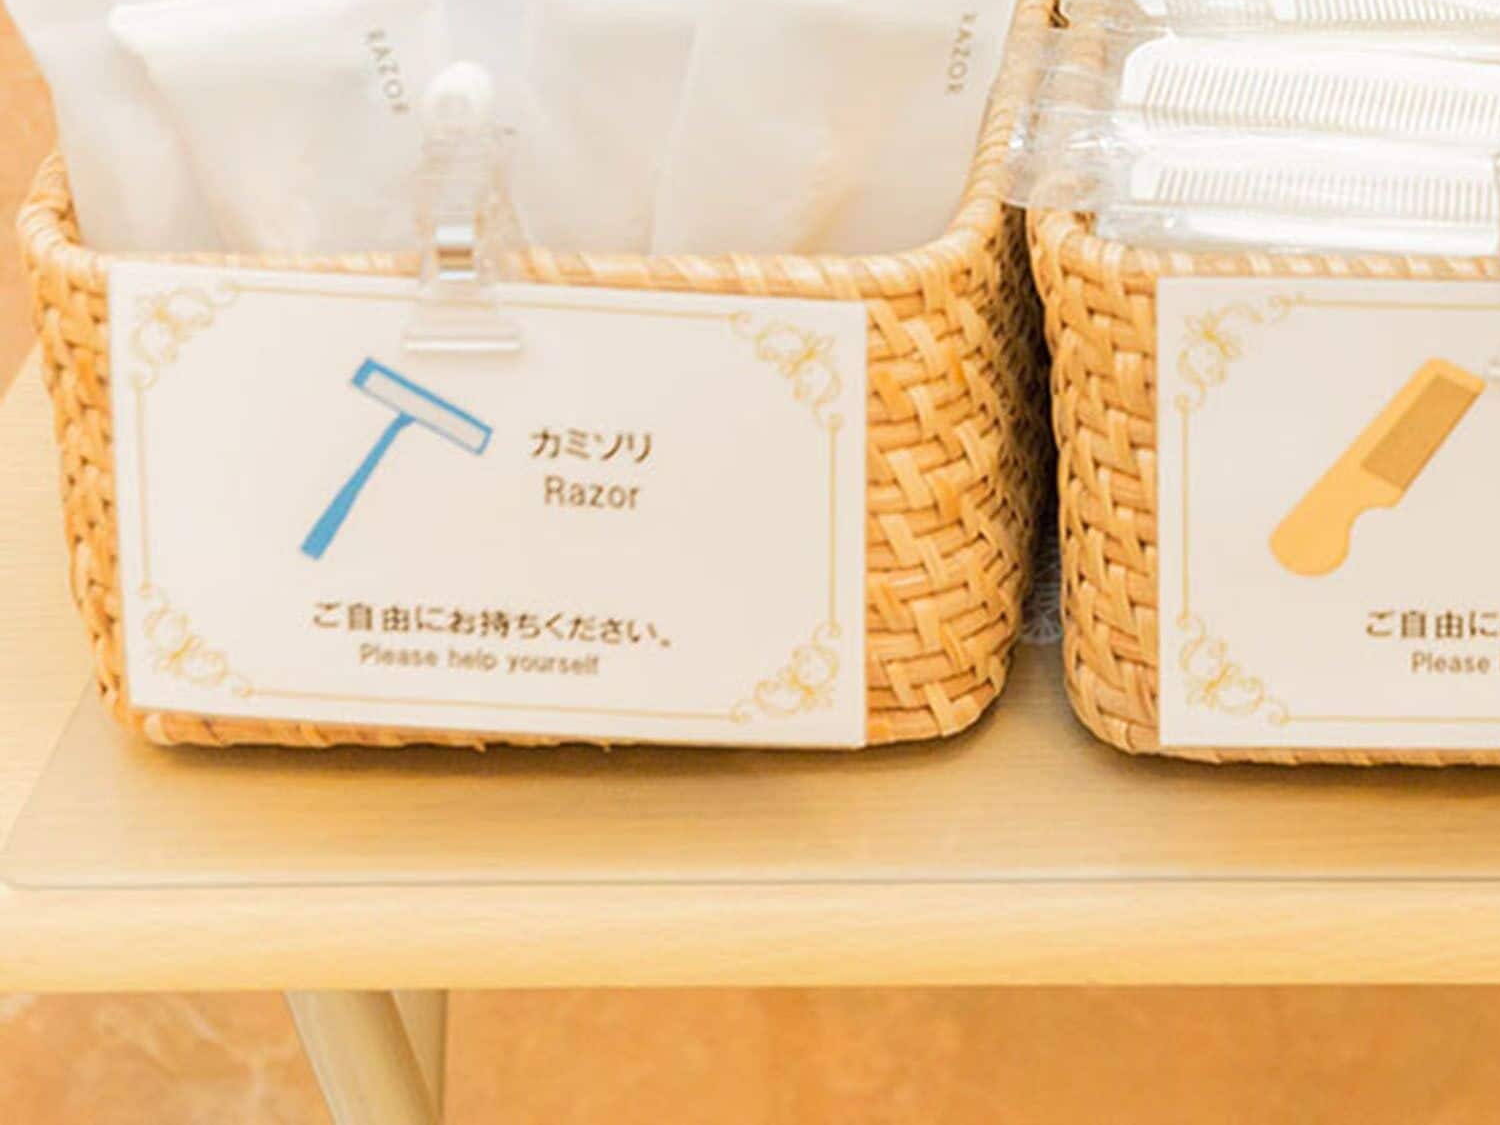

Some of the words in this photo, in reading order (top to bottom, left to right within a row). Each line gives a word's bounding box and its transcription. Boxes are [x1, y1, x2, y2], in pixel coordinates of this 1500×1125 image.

[530, 428, 653, 463] カミソリ
[543, 474, 640, 510] Razor
[313, 602, 671, 648] ご自由にお持ちください。
[359, 643, 439, 667] Please
[448, 648, 498, 671] help
[507, 653, 600, 676] yourself
[1411, 651, 1490, 674] Please
